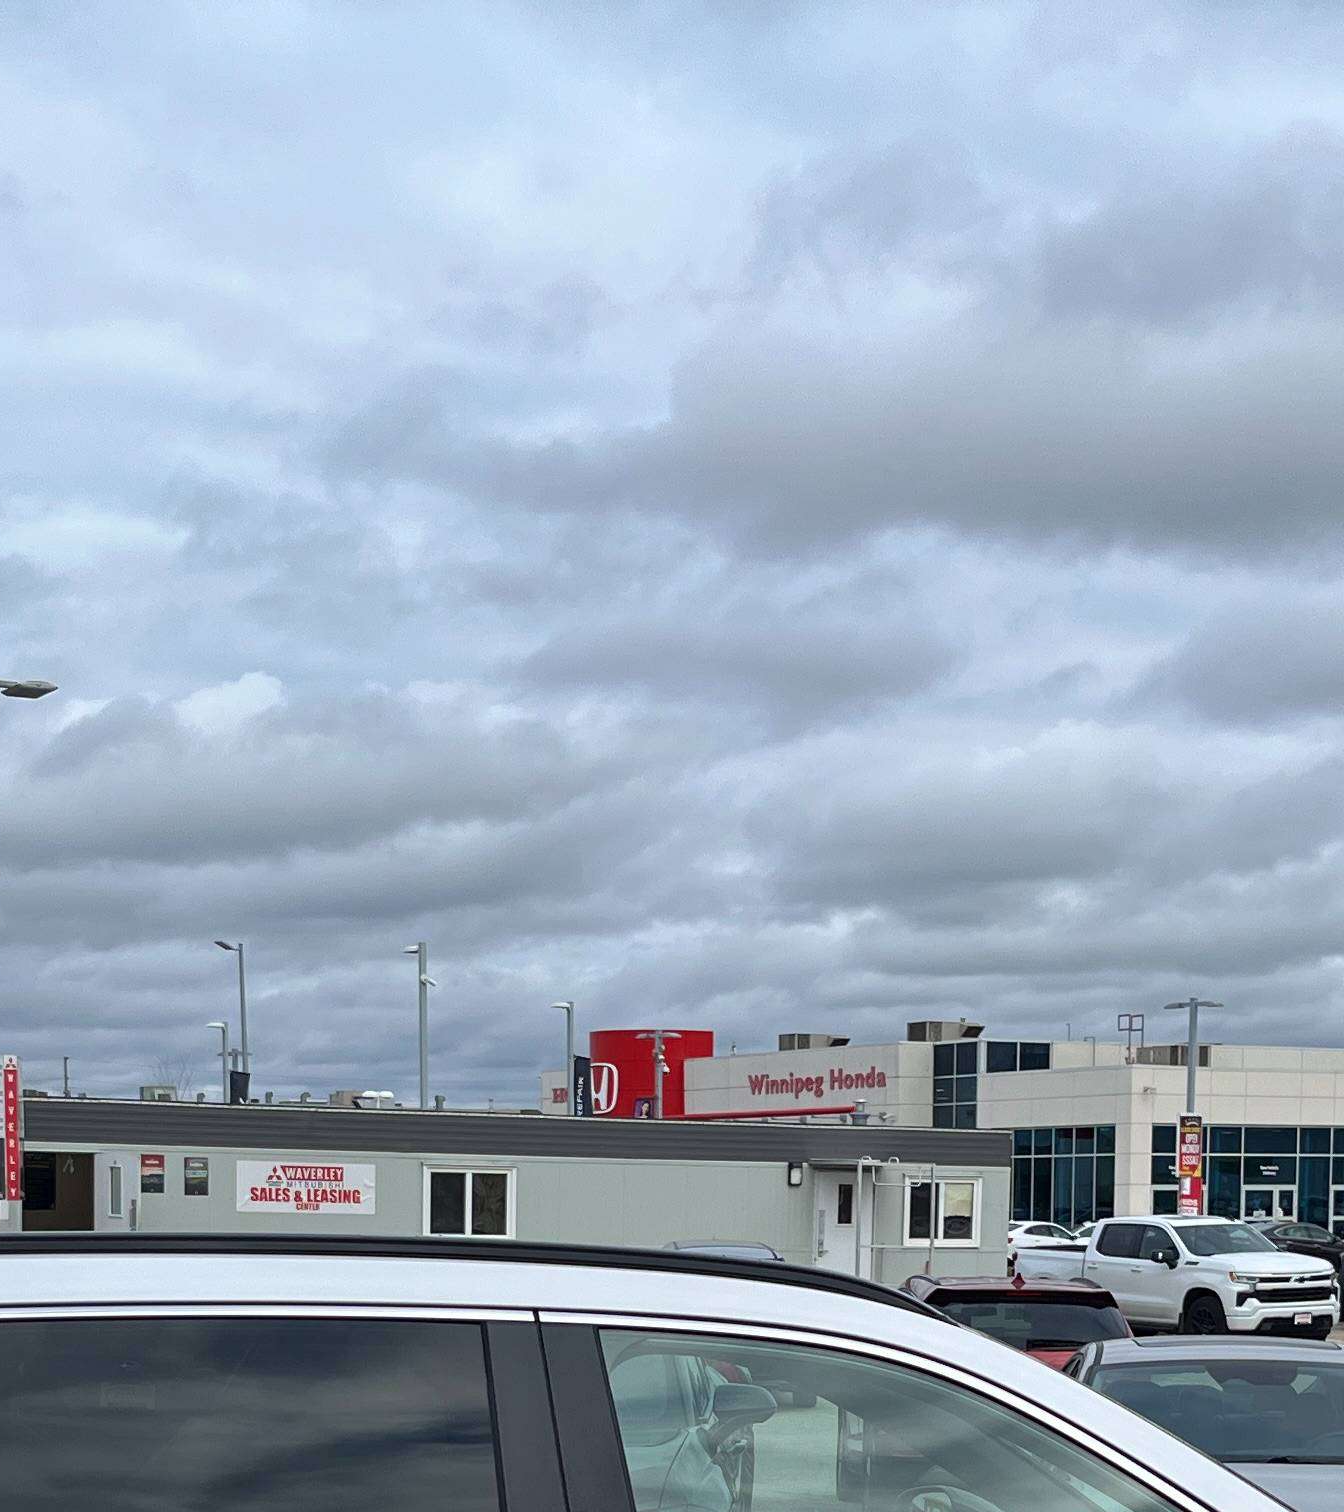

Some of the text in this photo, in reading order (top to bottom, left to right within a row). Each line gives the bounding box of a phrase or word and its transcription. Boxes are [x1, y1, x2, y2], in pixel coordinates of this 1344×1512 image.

[747, 1066, 887, 1099] Winnipeg Honda
[7, 1074, 17, 1197] WAVERLEY
[285, 1166, 343, 1180] WAVERLEY
[250, 1187, 361, 1204] SALES & LEASING
